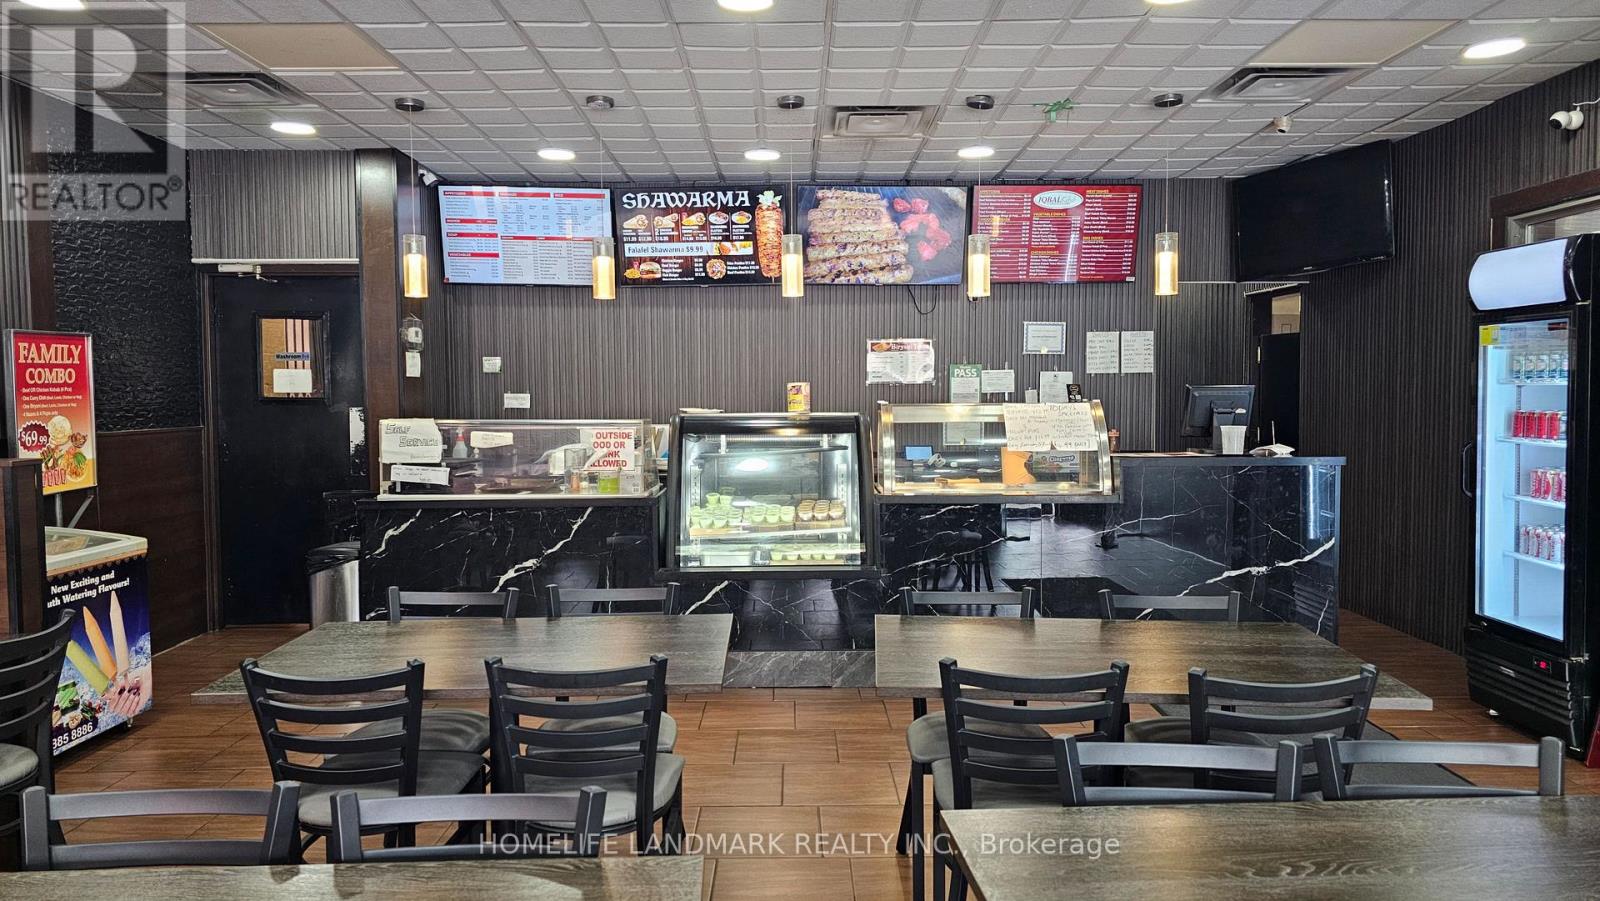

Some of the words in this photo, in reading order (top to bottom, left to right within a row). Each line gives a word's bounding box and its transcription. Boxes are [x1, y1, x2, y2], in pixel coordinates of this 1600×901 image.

[622, 190, 751, 210] SHAWARMA
[18, 342, 82, 364] FAMILY
[26, 368, 76, 384] COMBO
[954, 368, 977, 377] PASS
[21, 430, 48, 447] $69.99
[593, 441, 611, 449] OOD
[50, 584, 68, 595] New
[70, 576, 99, 589] Exciting
[101, 570, 114, 581] and
[62, 588, 96, 604] Watering
[98, 577, 130, 594] Flavours!
[52, 732, 69, 750] 385
[71, 722, 93, 740] 8886
